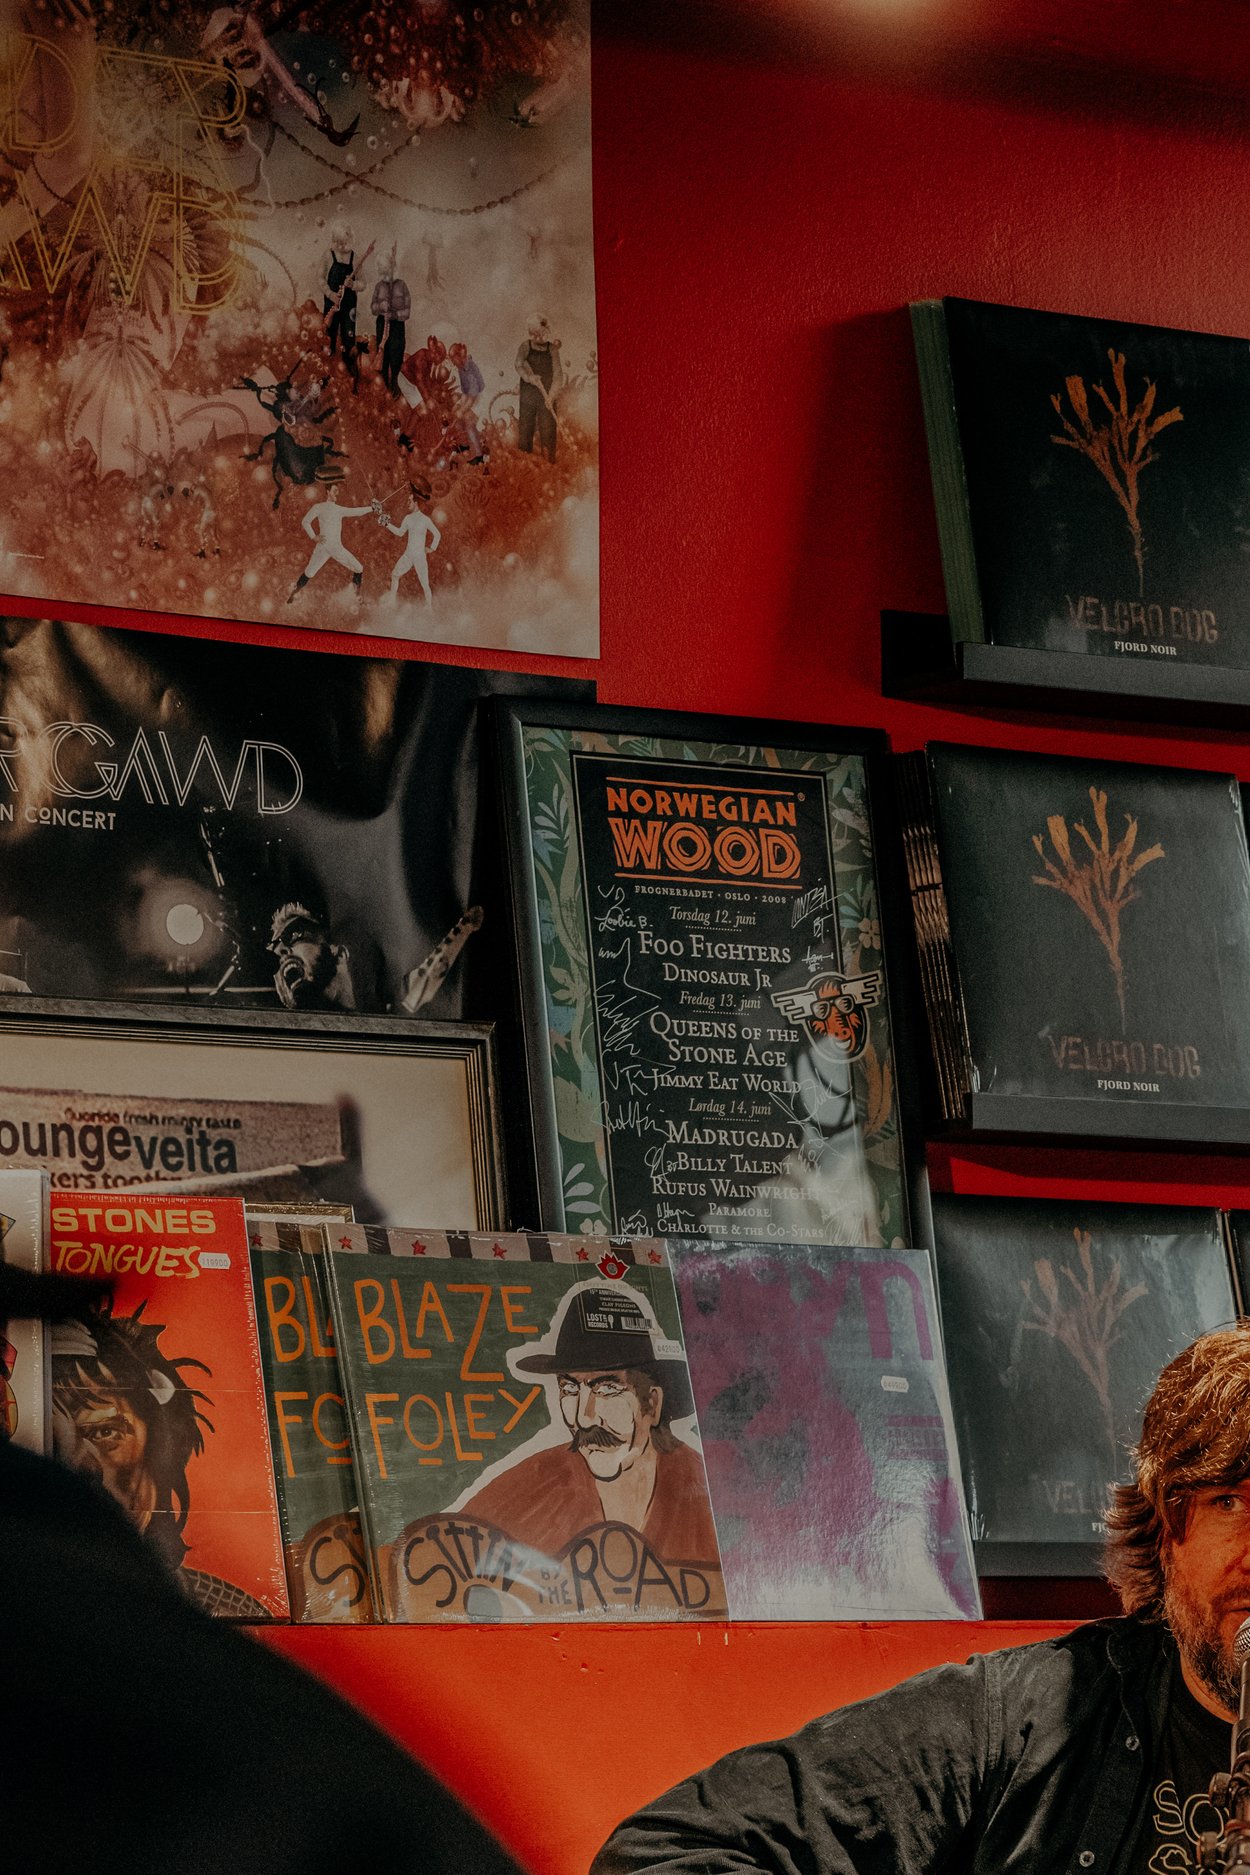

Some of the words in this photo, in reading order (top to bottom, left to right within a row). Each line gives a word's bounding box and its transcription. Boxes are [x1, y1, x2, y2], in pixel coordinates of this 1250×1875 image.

[1114, 640, 1148, 653] FJORD
[1149, 644, 1177, 656] NOIR
[606, 787, 798, 826] NORWEGIAN
[608, 818, 802, 879] WOOD
[634, 885, 714, 899] FROGNERBADET
[725, 892, 751, 901] OSLO
[762, 895, 787, 904] 2008
[669, 906, 711, 925] Torsdag
[714, 910, 732, 924] 12.
[733, 912, 757, 928] juni
[637, 930, 684, 956] FOO
[689, 934, 791, 964] FIGHTERS
[662, 962, 751, 987] DINOSAUR
[755, 969, 772, 992] JR
[679, 991, 715, 1010] Fredag
[719, 996, 737, 1009] 13.
[738, 997, 761, 1012] juni
[650, 1011, 737, 1042] QUEENS
[741, 1027, 762, 1040] OF
[766, 1029, 800, 1043] THE
[668, 1038, 738, 1065] STONE
[742, 1043, 788, 1067] AGE
[651, 1068, 703, 1091] JIMMY
[707, 1071, 739, 1090] EAT
[742, 1073, 801, 1094] WORLD
[1097, 1079, 1131, 1091] FJORD
[1132, 1082, 1160, 1093] NOIR
[689, 1098, 725, 1116] Lørdag
[730, 1101, 747, 1114] 14.
[750, 1102, 771, 1118] juni
[665, 1120, 799, 1148] MADRUGADA
[677, 1152, 727, 1172] BILLY
[730, 1154, 793, 1175] TALENT
[652, 1176, 706, 1197] RUFUS
[51, 1207, 216, 1234] STONES
[708, 1203, 771, 1218] PARAMORE
[656, 1218, 728, 1235] CHARLOTTE
[731, 1224, 741, 1235] &
[743, 1227, 763, 1236] THE
[766, 1223, 824, 1239] CO-STARS
[52, 1240, 201, 1279] TONGUES
[354, 1277, 538, 1382] BLAZE
[586, 1313, 603, 1321] LOST
[364, 1386, 542, 1479] FOLEY
[570, 1526, 711, 1613] ROAD
[539, 1579, 573, 1605] THE
